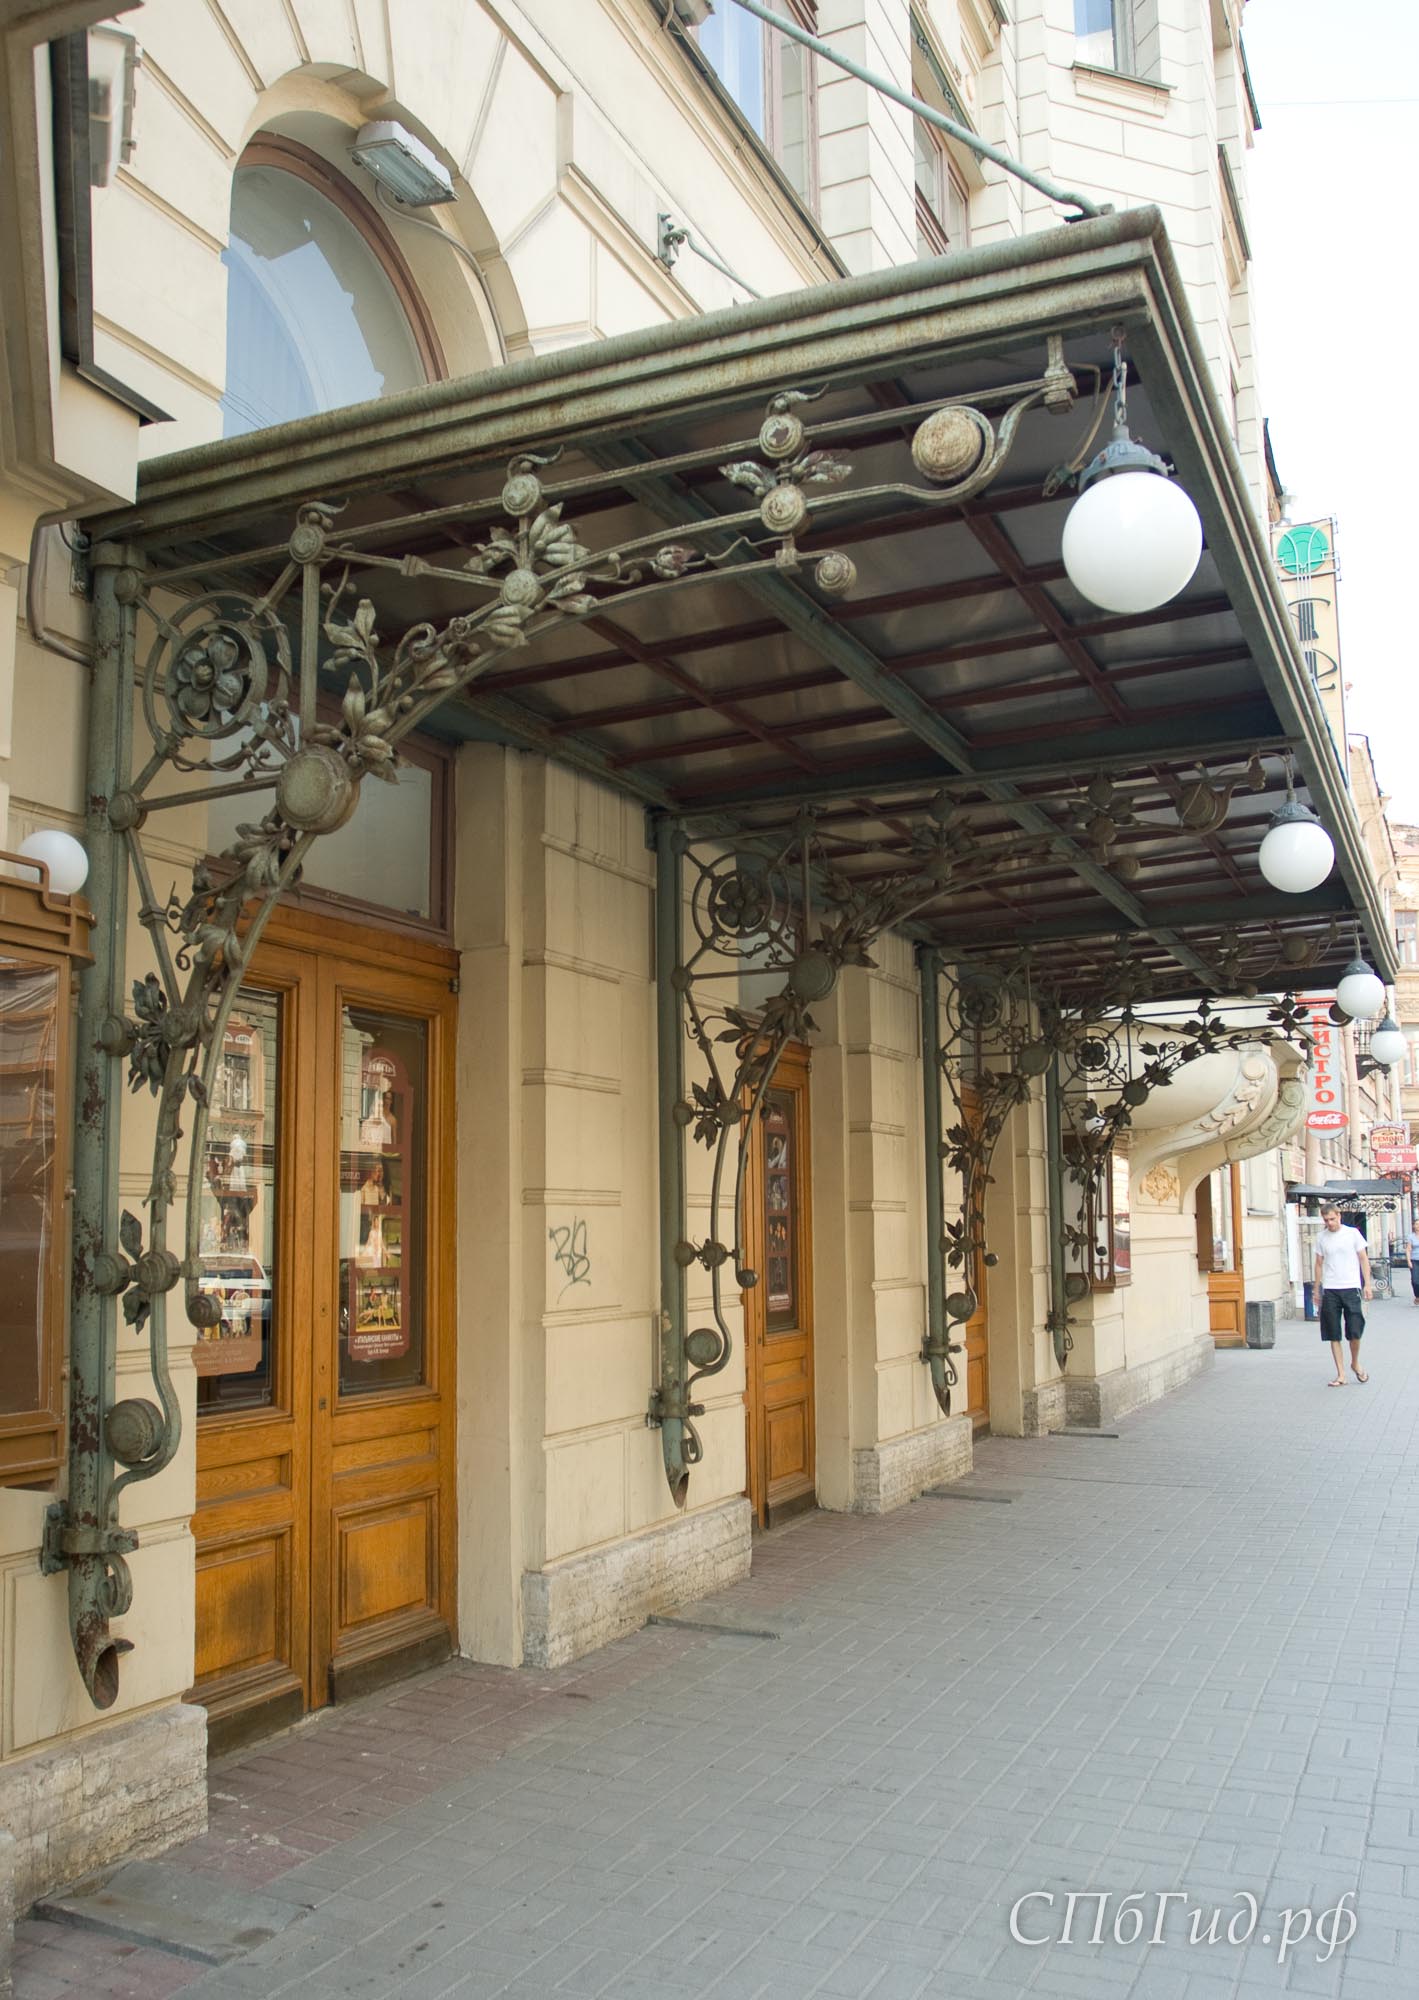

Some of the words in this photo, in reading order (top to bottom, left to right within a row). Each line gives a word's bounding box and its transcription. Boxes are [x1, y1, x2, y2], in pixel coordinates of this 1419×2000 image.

[1311, 1015, 1335, 1104] БИСТРО
[1372, 1135, 1404, 1143] РЕМОНТ
[1391, 1154, 1403, 1163] 24
